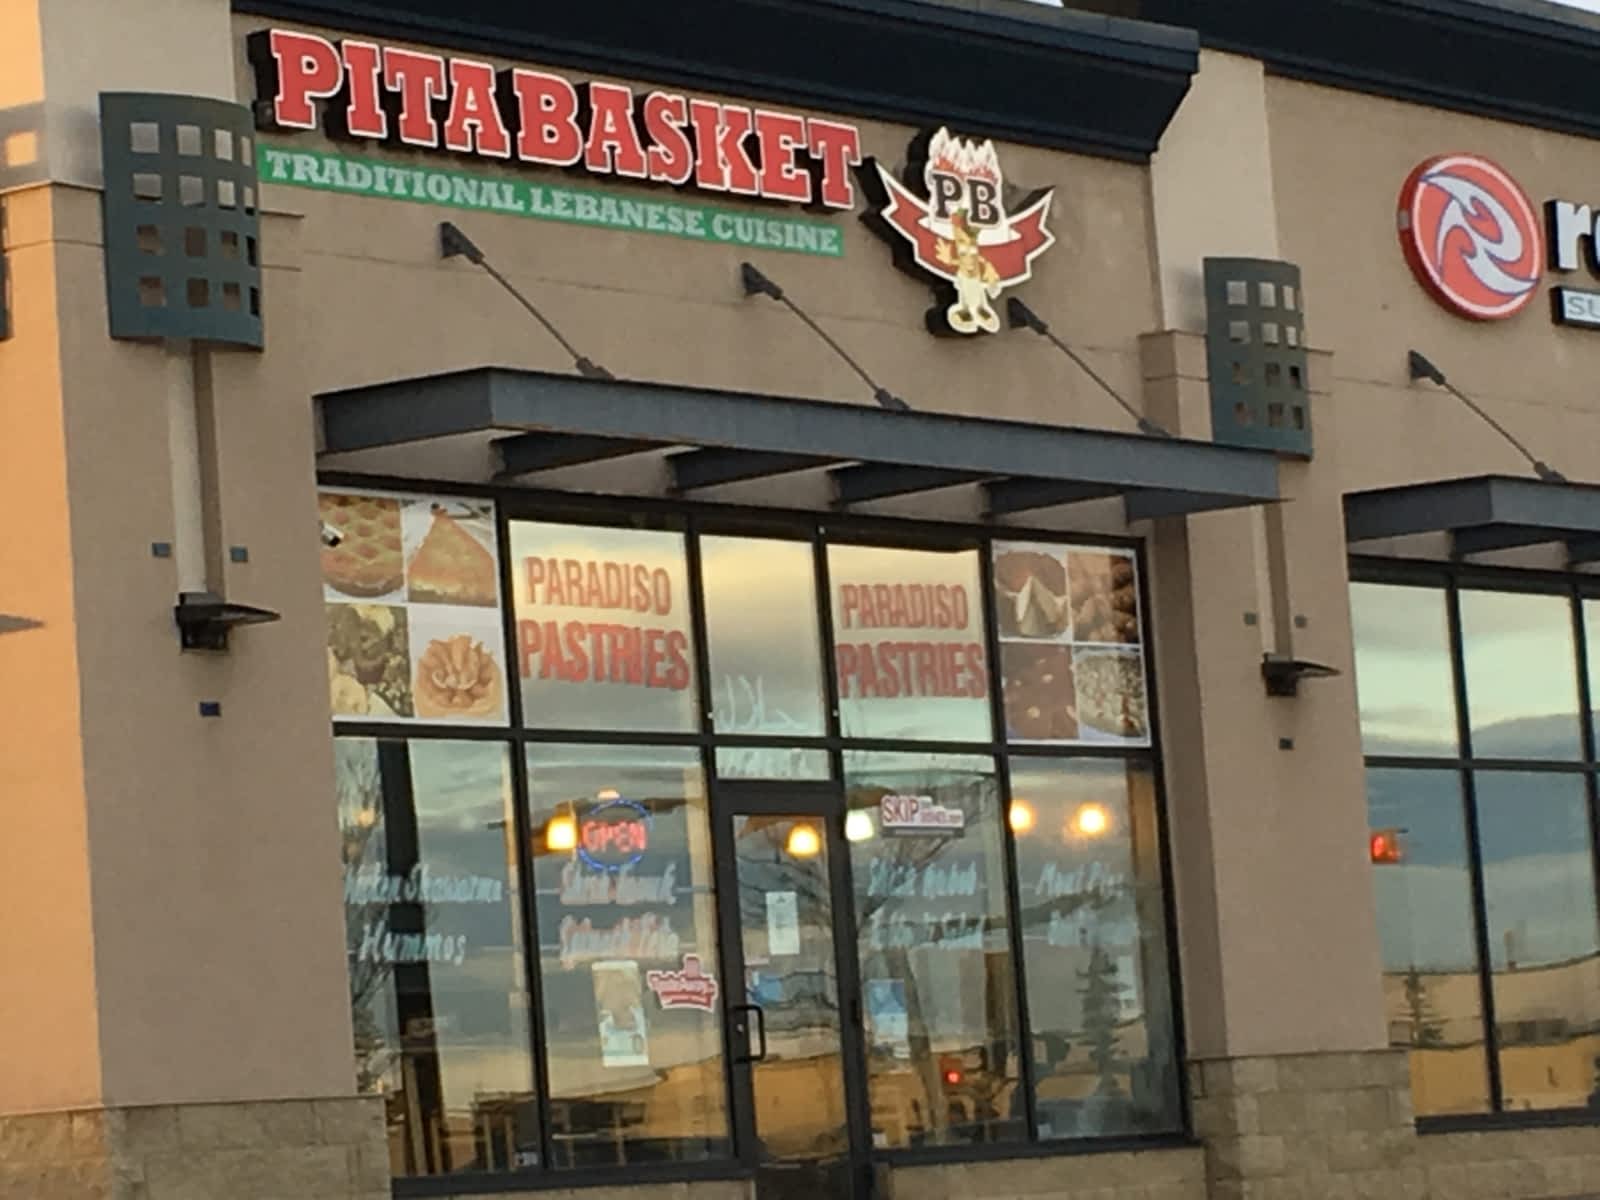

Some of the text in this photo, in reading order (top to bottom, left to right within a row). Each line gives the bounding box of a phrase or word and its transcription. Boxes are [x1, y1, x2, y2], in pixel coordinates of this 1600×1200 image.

[266, 151, 840, 253] TRADITIONAL LEBANESE CUISINE
[1556, 200, 1600, 270] r
[525, 556, 672, 616] PARADISO
[840, 584, 968, 630] PARADISO
[519, 619, 691, 691] PASTRIES
[836, 641, 986, 698] PASTRIES
[582, 820, 646, 852] OPEN
[883, 797, 919, 823] SKIP
